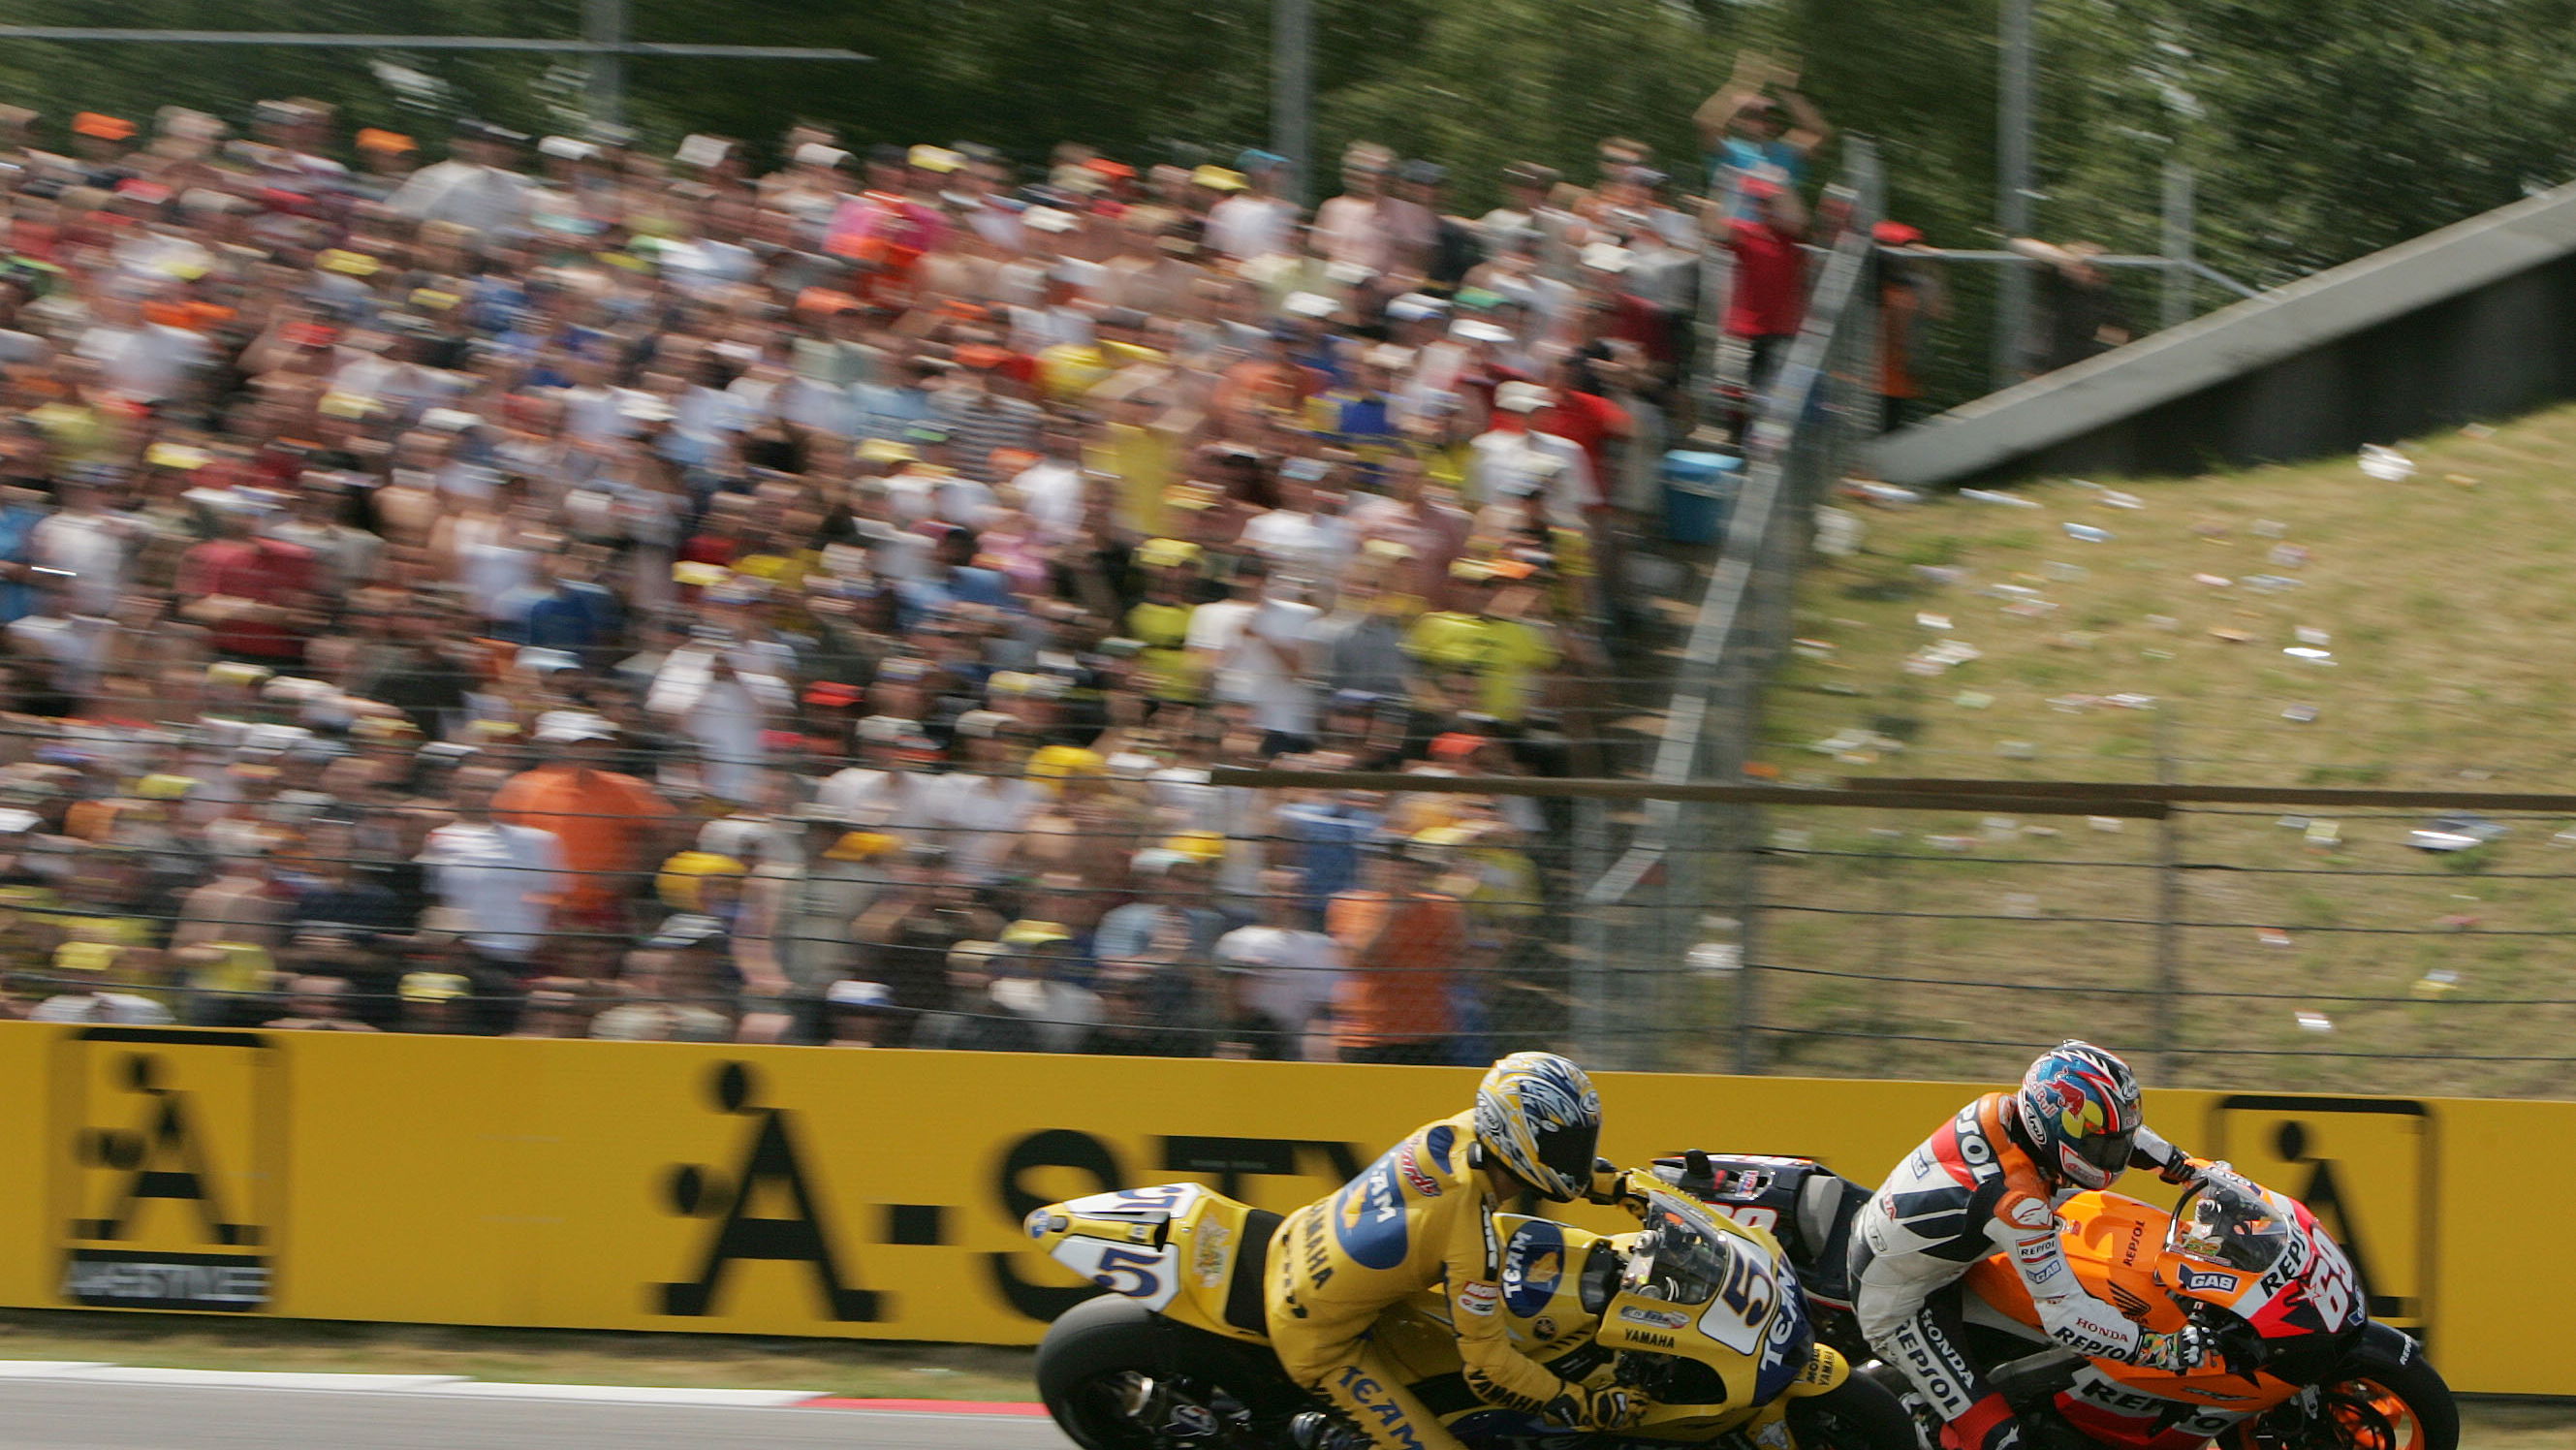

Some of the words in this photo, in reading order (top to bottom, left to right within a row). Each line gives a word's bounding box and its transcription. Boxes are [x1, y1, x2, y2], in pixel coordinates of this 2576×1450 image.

[1956, 1099, 2002, 1184] PSOL
[1502, 1231, 1532, 1299] TEAM
[2021, 1240, 2056, 1256] REPSOL
[2122, 1219, 2146, 1268] REPSOL
[1093, 1247, 1161, 1298] 5
[1722, 1248, 1775, 1328] 5
[2189, 1275, 2234, 1291] GAS
[1624, 1328, 1676, 1348] YAMAHA
[1921, 1308, 1975, 1389] HONDA
[2076, 1316, 2129, 1342] HONDA
[1468, 1368, 1545, 1416] YAMAHA
